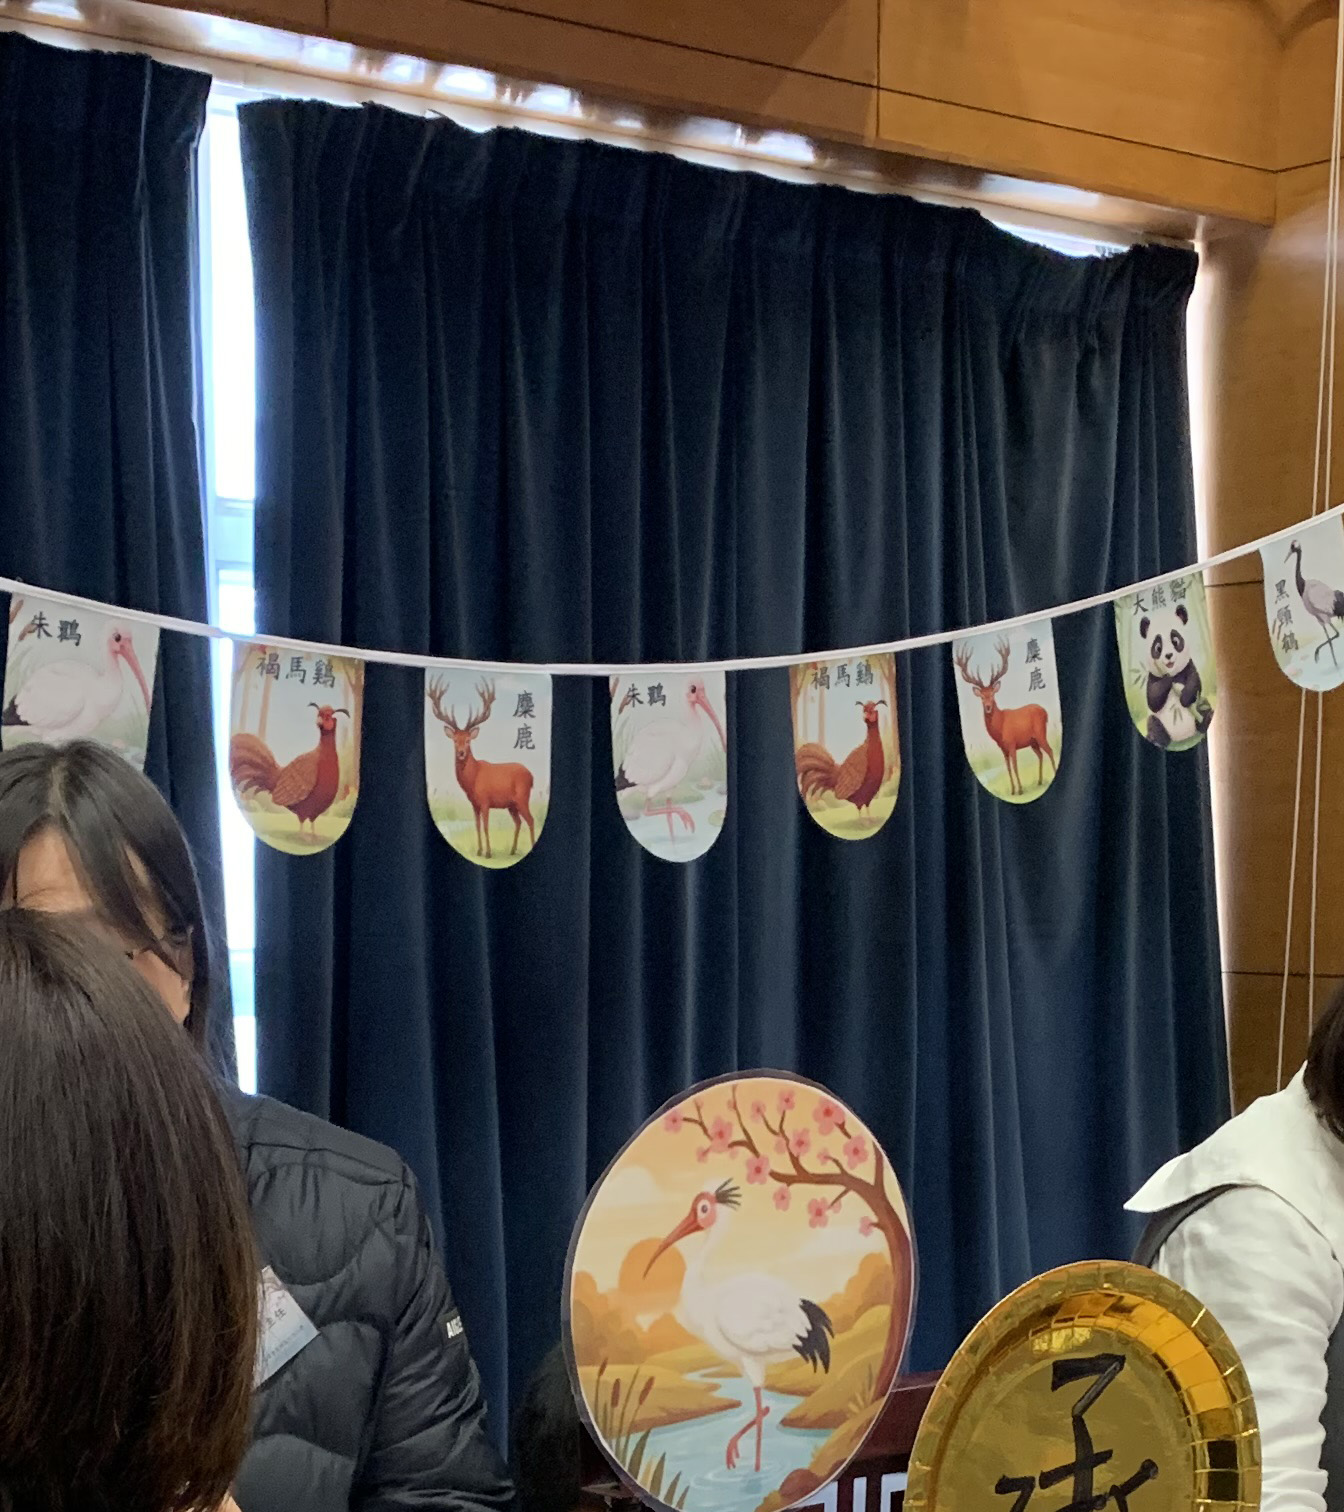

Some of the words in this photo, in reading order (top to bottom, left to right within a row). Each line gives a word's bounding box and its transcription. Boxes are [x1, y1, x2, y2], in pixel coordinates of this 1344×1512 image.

[1133, 578, 1189, 615] 大熊貓
[1025, 637, 1046, 692] 麋鹿
[512, 690, 536, 750] 麋鹿
